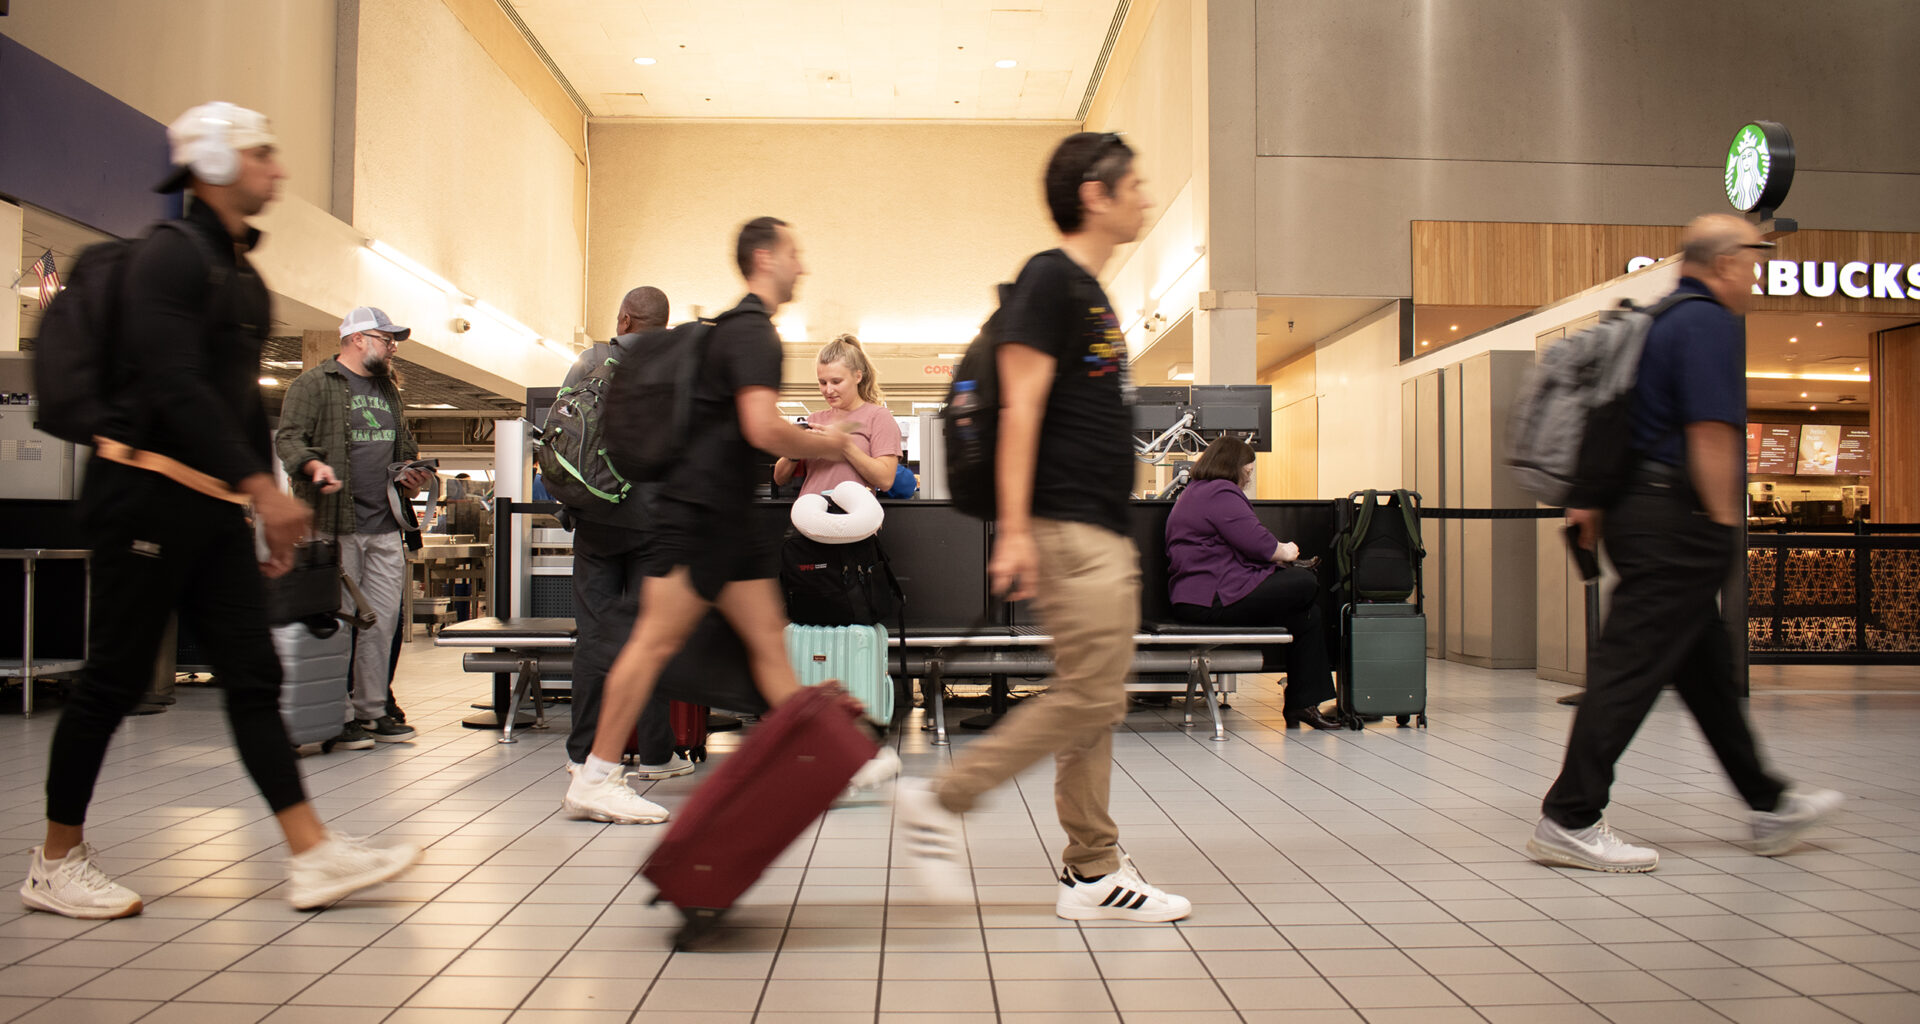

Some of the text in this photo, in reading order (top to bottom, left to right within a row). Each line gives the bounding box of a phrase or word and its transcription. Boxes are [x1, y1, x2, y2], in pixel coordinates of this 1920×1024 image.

[1627, 256, 1920, 301] BUCKS
[924, 365, 954, 376] COR
[368, 396, 392, 413] TEXA
